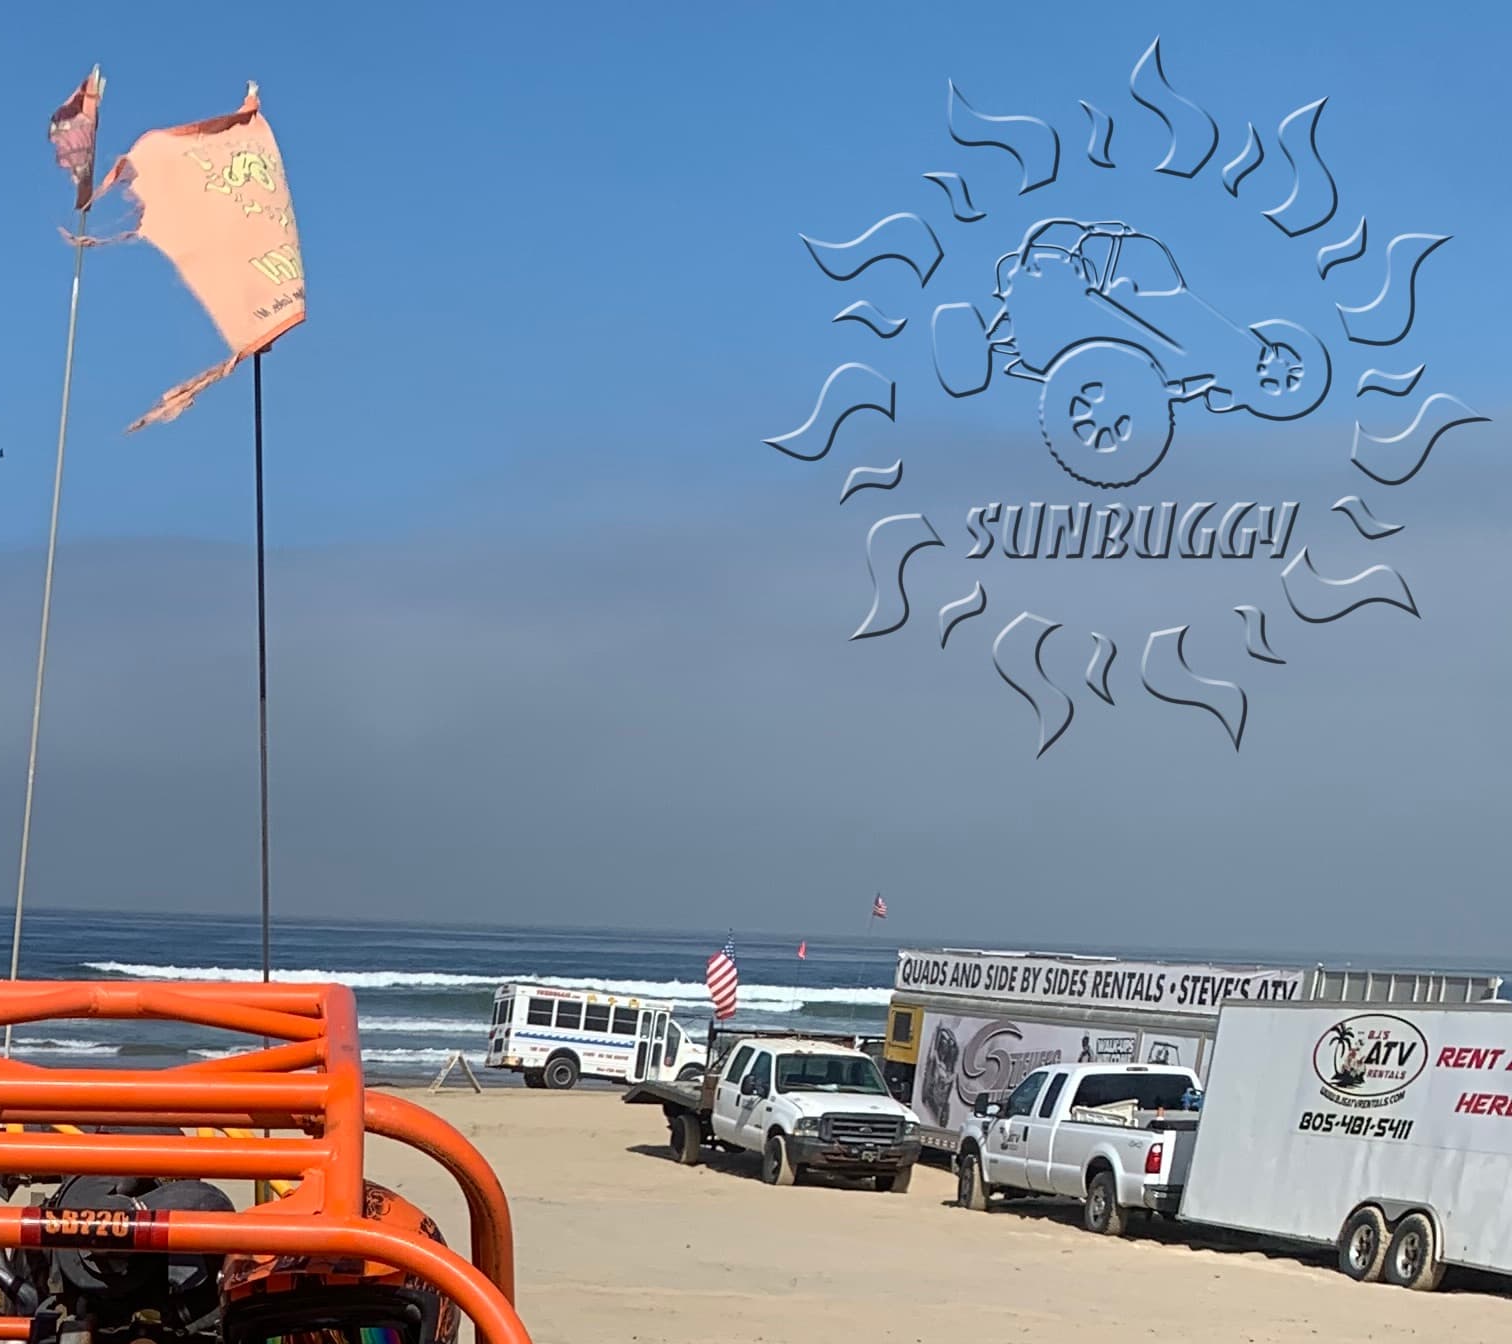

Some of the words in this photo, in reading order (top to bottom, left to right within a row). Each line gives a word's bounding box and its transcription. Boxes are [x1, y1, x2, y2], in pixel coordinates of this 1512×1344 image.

[902, 958, 948, 986] QUADS
[949, 962, 982, 988] AND
[984, 964, 1018, 991] SIDE
[1020, 967, 1043, 994] BY
[1043, 967, 1089, 998] SIDES
[1090, 970, 1166, 1002] RENTALS
[1178, 974, 1251, 1007] STEVE'S
[1256, 979, 1298, 1001] ATV
[1364, 1040, 1417, 1066] ATV
[1436, 1047, 1506, 1070] RENT
[1367, 1069, 1407, 1080] RENTALS
[1299, 1112, 1414, 1140] 805-481-5411
